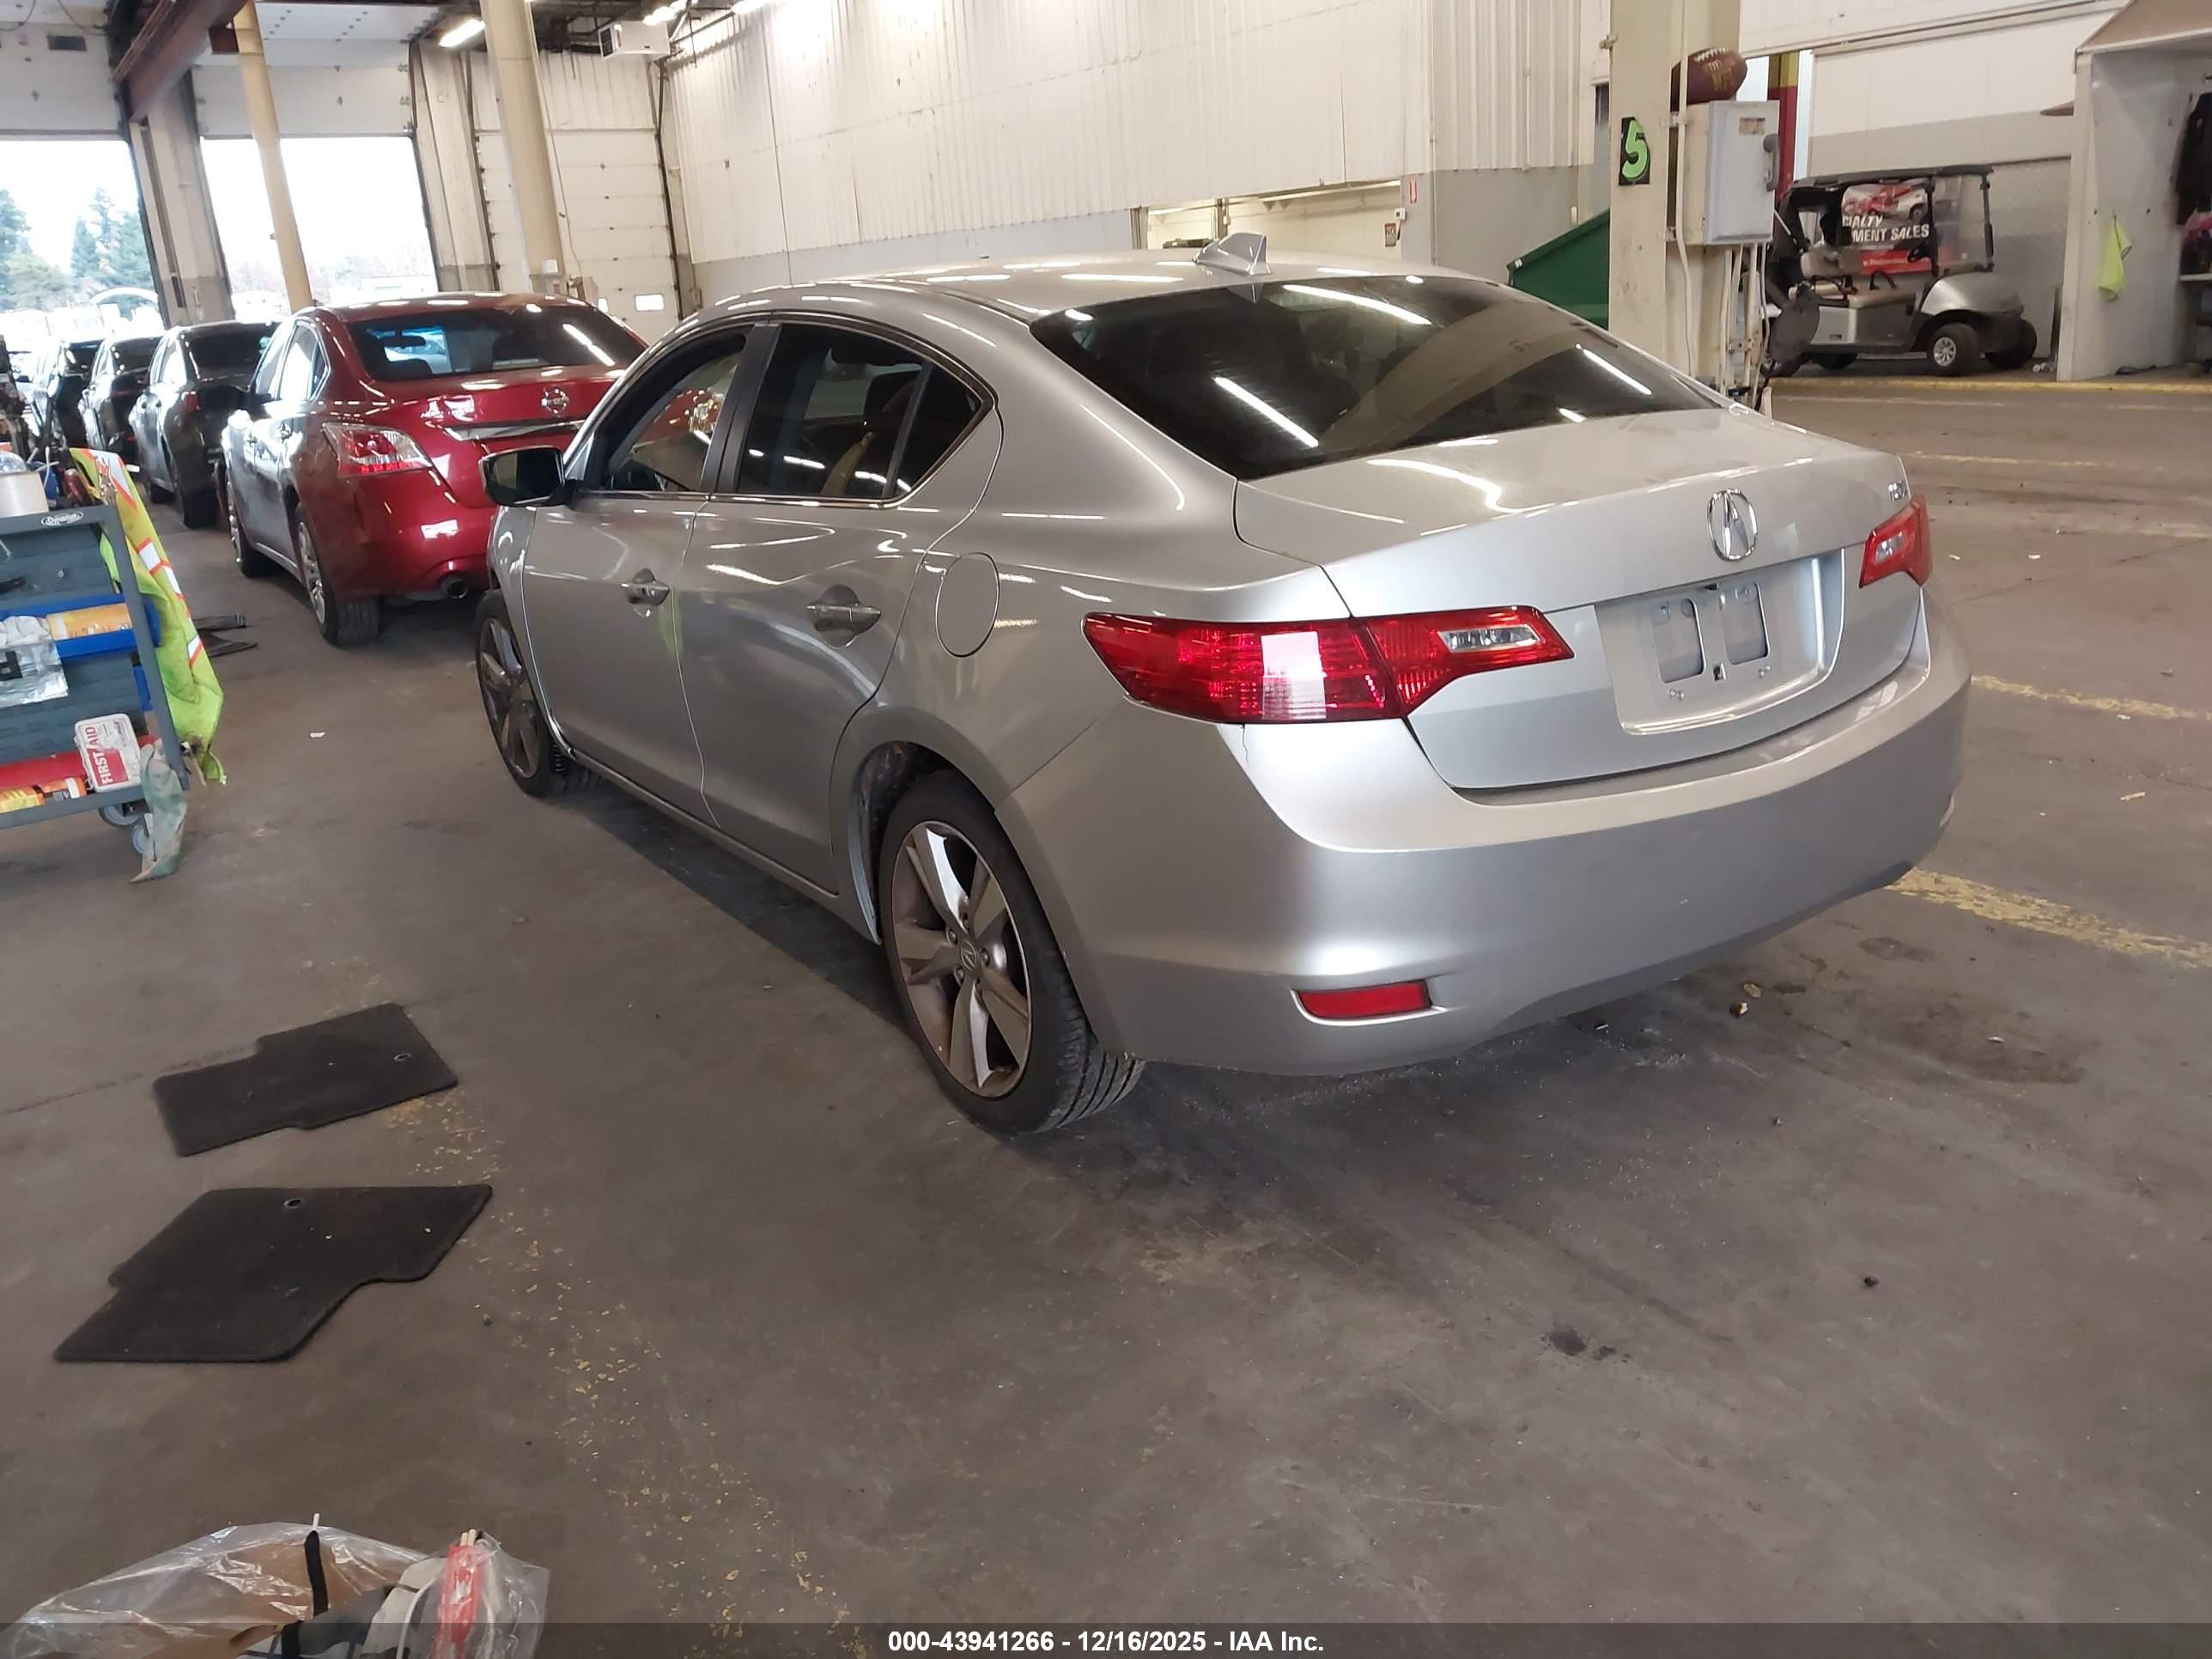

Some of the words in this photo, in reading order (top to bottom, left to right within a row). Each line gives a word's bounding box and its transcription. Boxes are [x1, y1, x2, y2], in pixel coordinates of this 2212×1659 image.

[1622, 120, 1649, 178] 5
[1890, 223, 1929, 240] SALES
[85, 726, 99, 744] AID
[92, 751, 113, 784] FIRST
